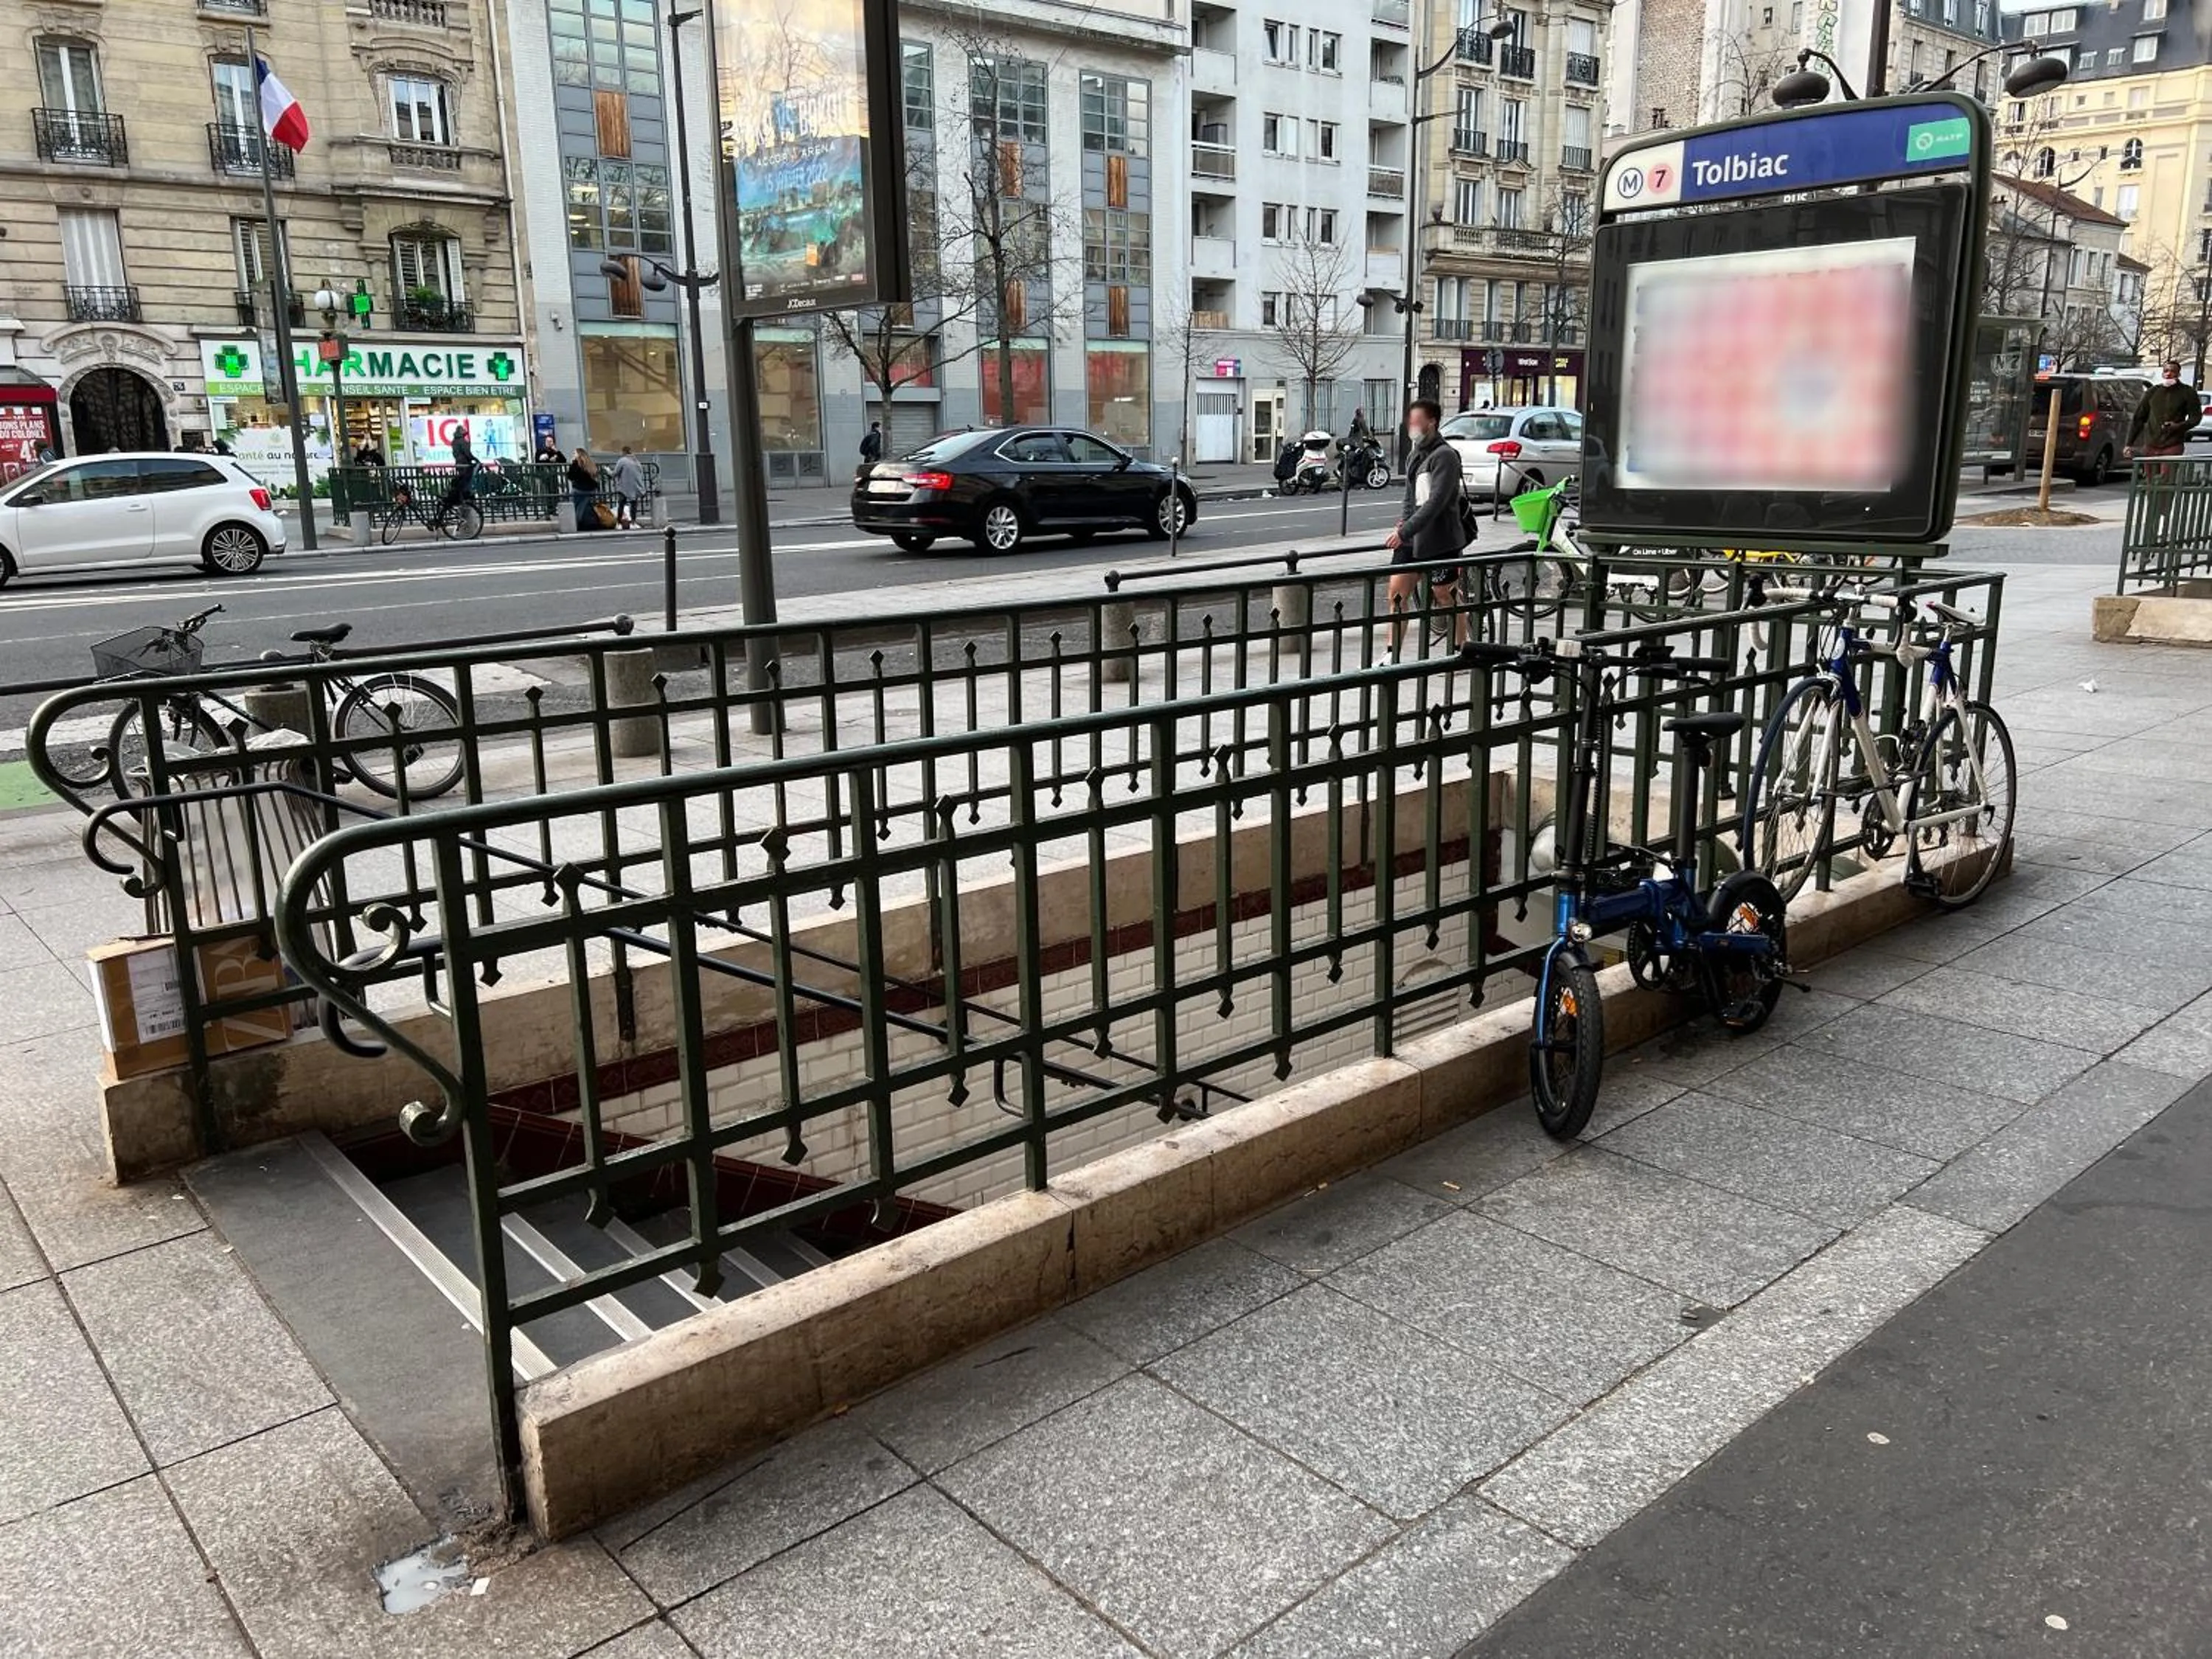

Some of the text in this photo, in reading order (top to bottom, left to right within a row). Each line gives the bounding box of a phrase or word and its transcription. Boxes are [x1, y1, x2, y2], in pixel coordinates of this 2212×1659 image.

[801, 142, 835, 157] ARENA
[1655, 170, 1666, 188] 7
[1691, 152, 1790, 187] Tolbiac
[295, 349, 476, 379] HARMACIE
[220, 384, 264, 394] ESPACE
[424, 386, 516, 396] ESPACE BIEN ETRE
[19, 420, 44, 429] PLANS
[236, 451, 264, 461] anté
[266, 451, 281, 460] au
[207, 935, 286, 1051] ZRA
